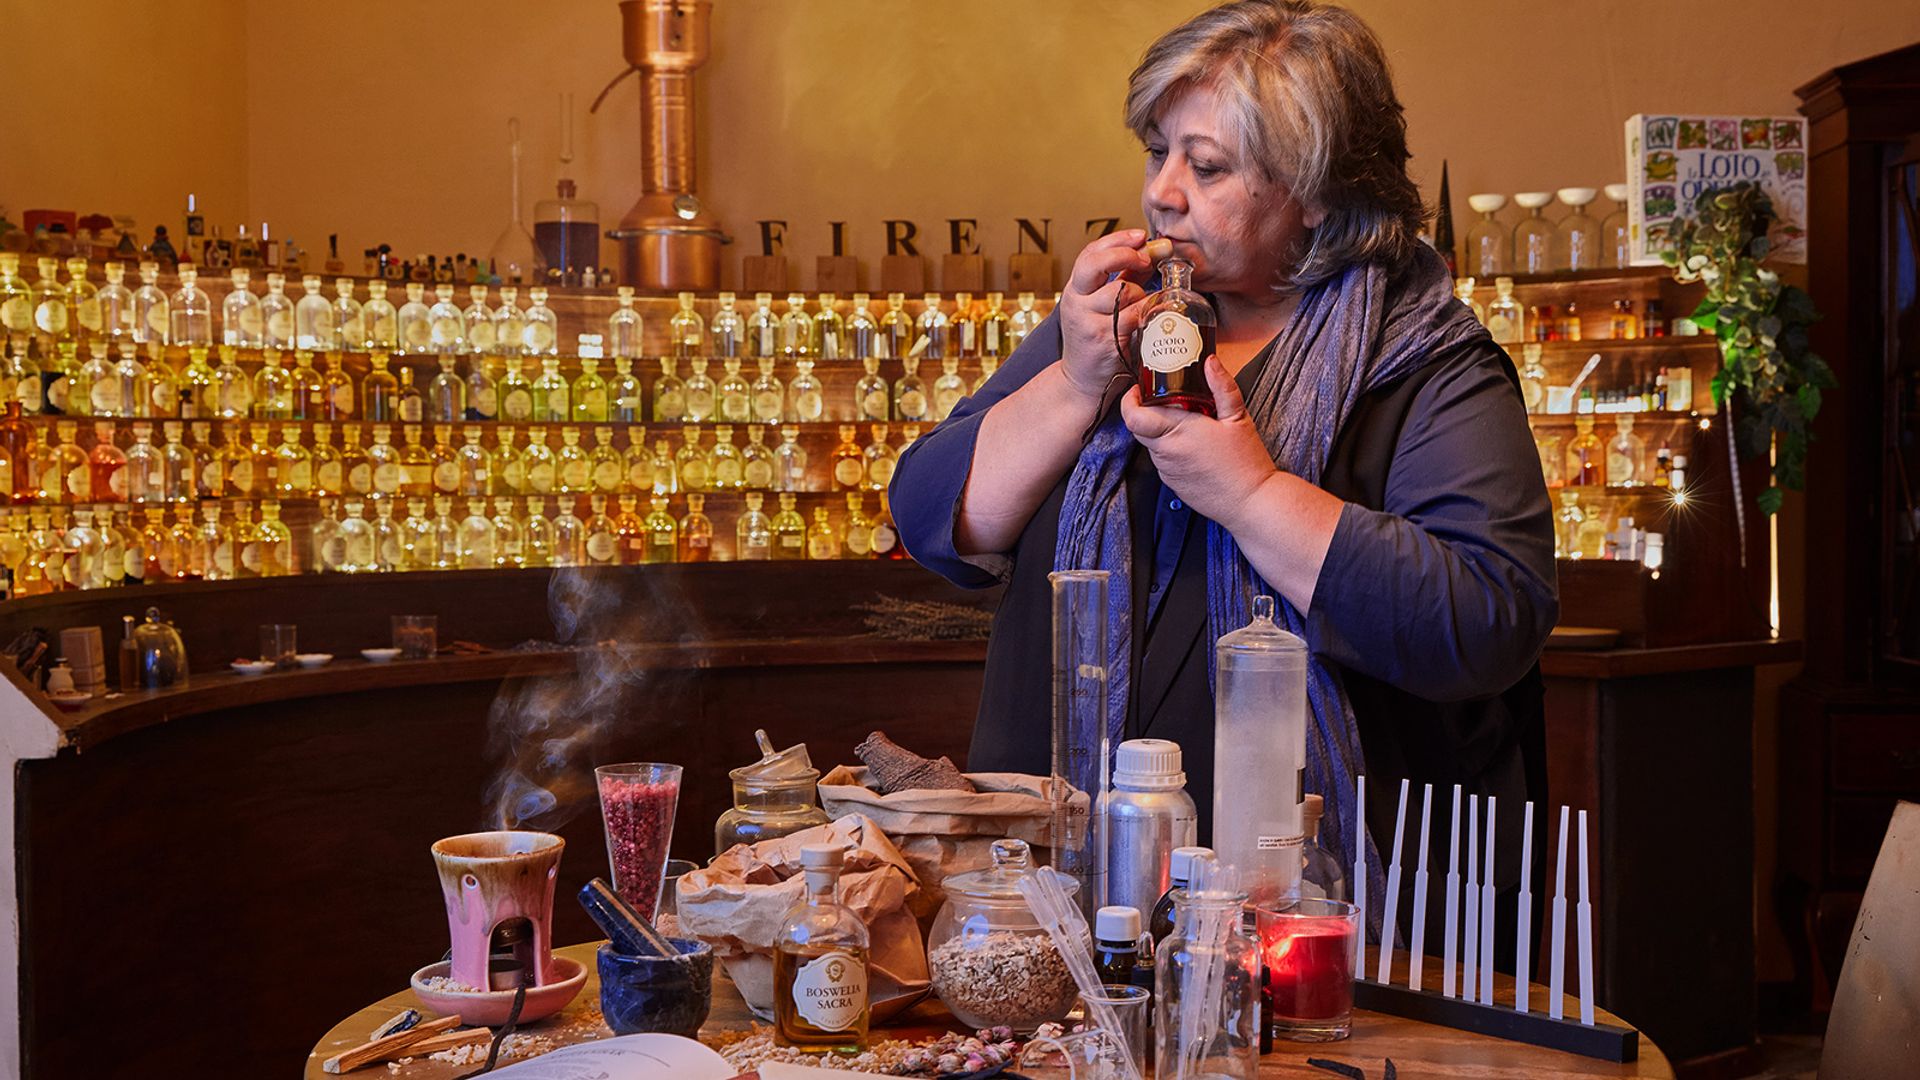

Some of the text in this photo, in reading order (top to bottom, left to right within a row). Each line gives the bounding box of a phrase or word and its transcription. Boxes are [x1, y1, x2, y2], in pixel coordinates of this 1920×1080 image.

[1698, 153, 1761, 179] LOTO
[1152, 337, 1186, 348] CUOIO
[1151, 346, 1188, 358] ANTICO
[806, 984, 861, 997] BOSWELIA
[817, 997, 853, 1009] SACRA
